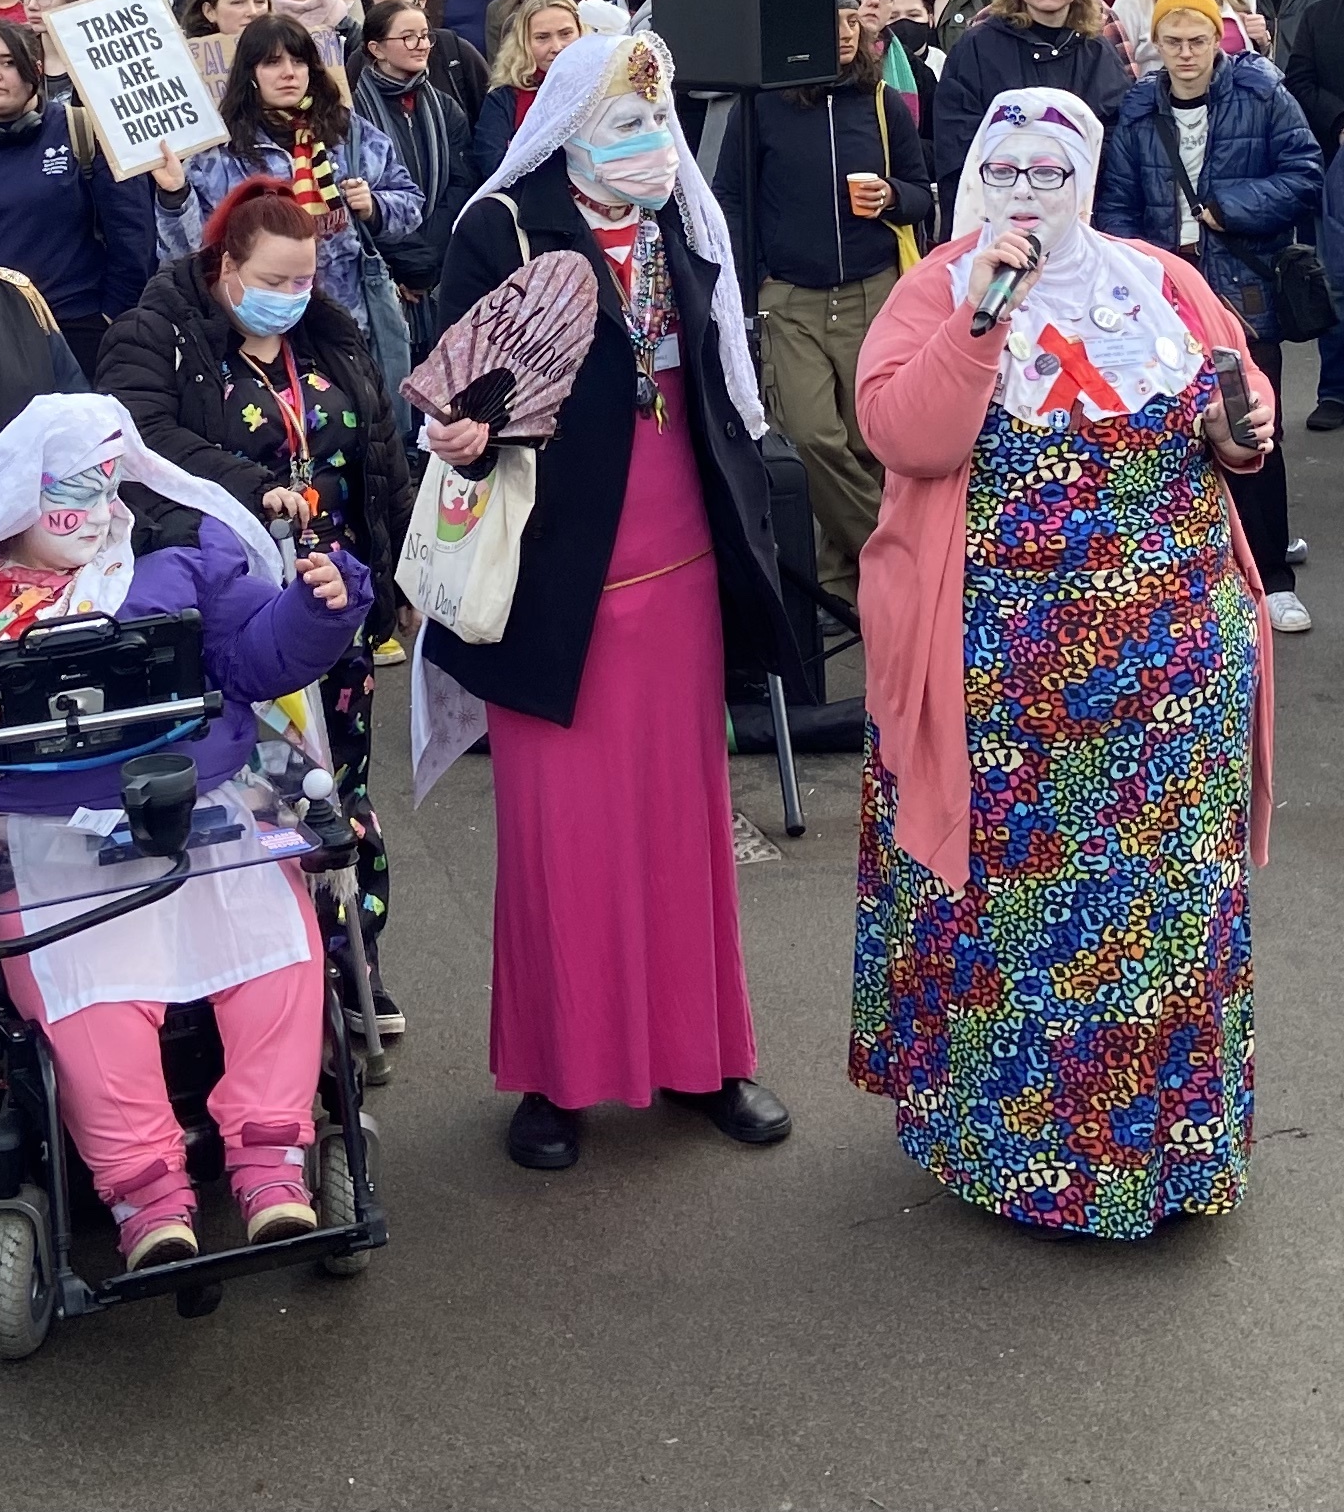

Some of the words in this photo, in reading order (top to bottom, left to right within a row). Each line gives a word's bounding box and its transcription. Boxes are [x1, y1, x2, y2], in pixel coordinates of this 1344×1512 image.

[77, 3, 148, 43] TRANS
[86, 27, 163, 70] RIGHTS
[118, 57, 160, 89] ARE
[110, 76, 188, 120] HUMAN
[122, 102, 199, 145] RIGHTS
[472, 282, 575, 383] Fabulous
[48, 513, 78, 529] NO
